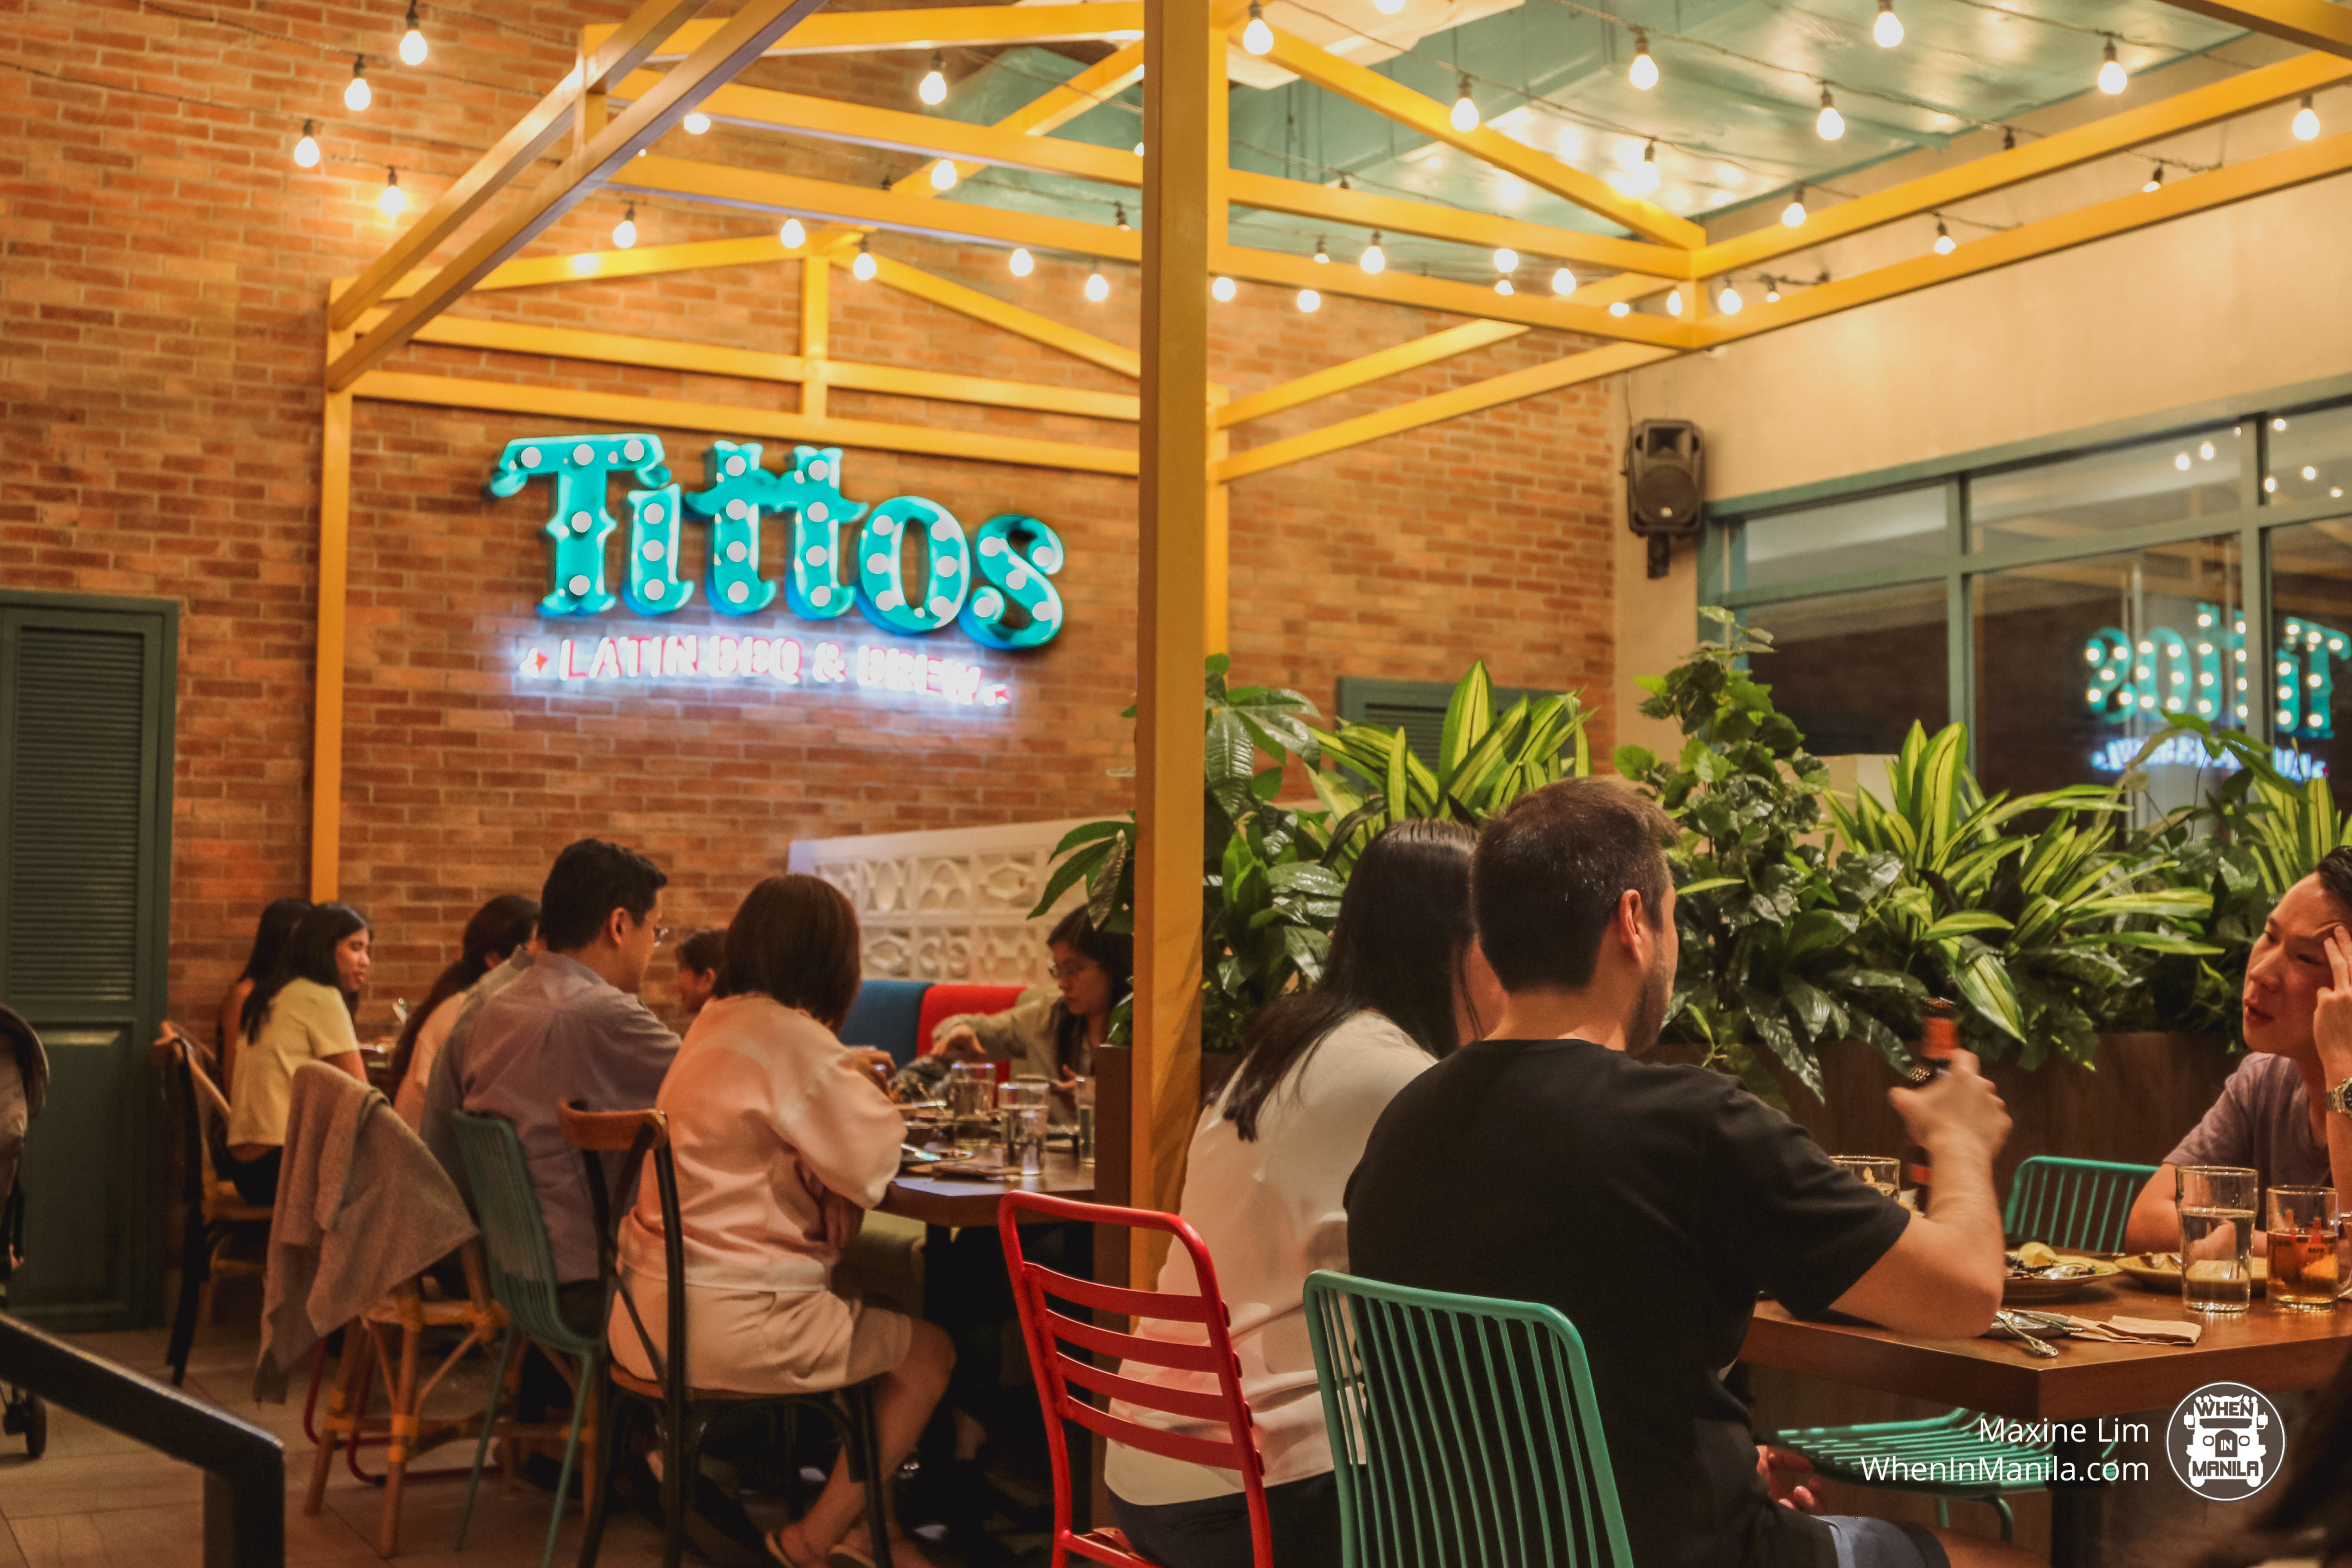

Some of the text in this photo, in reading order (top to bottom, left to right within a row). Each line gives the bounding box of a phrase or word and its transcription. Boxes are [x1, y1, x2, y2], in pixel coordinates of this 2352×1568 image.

[490, 433, 1064, 650] Tittos
[558, 634, 985, 705] LATIN BBQ & BREW
